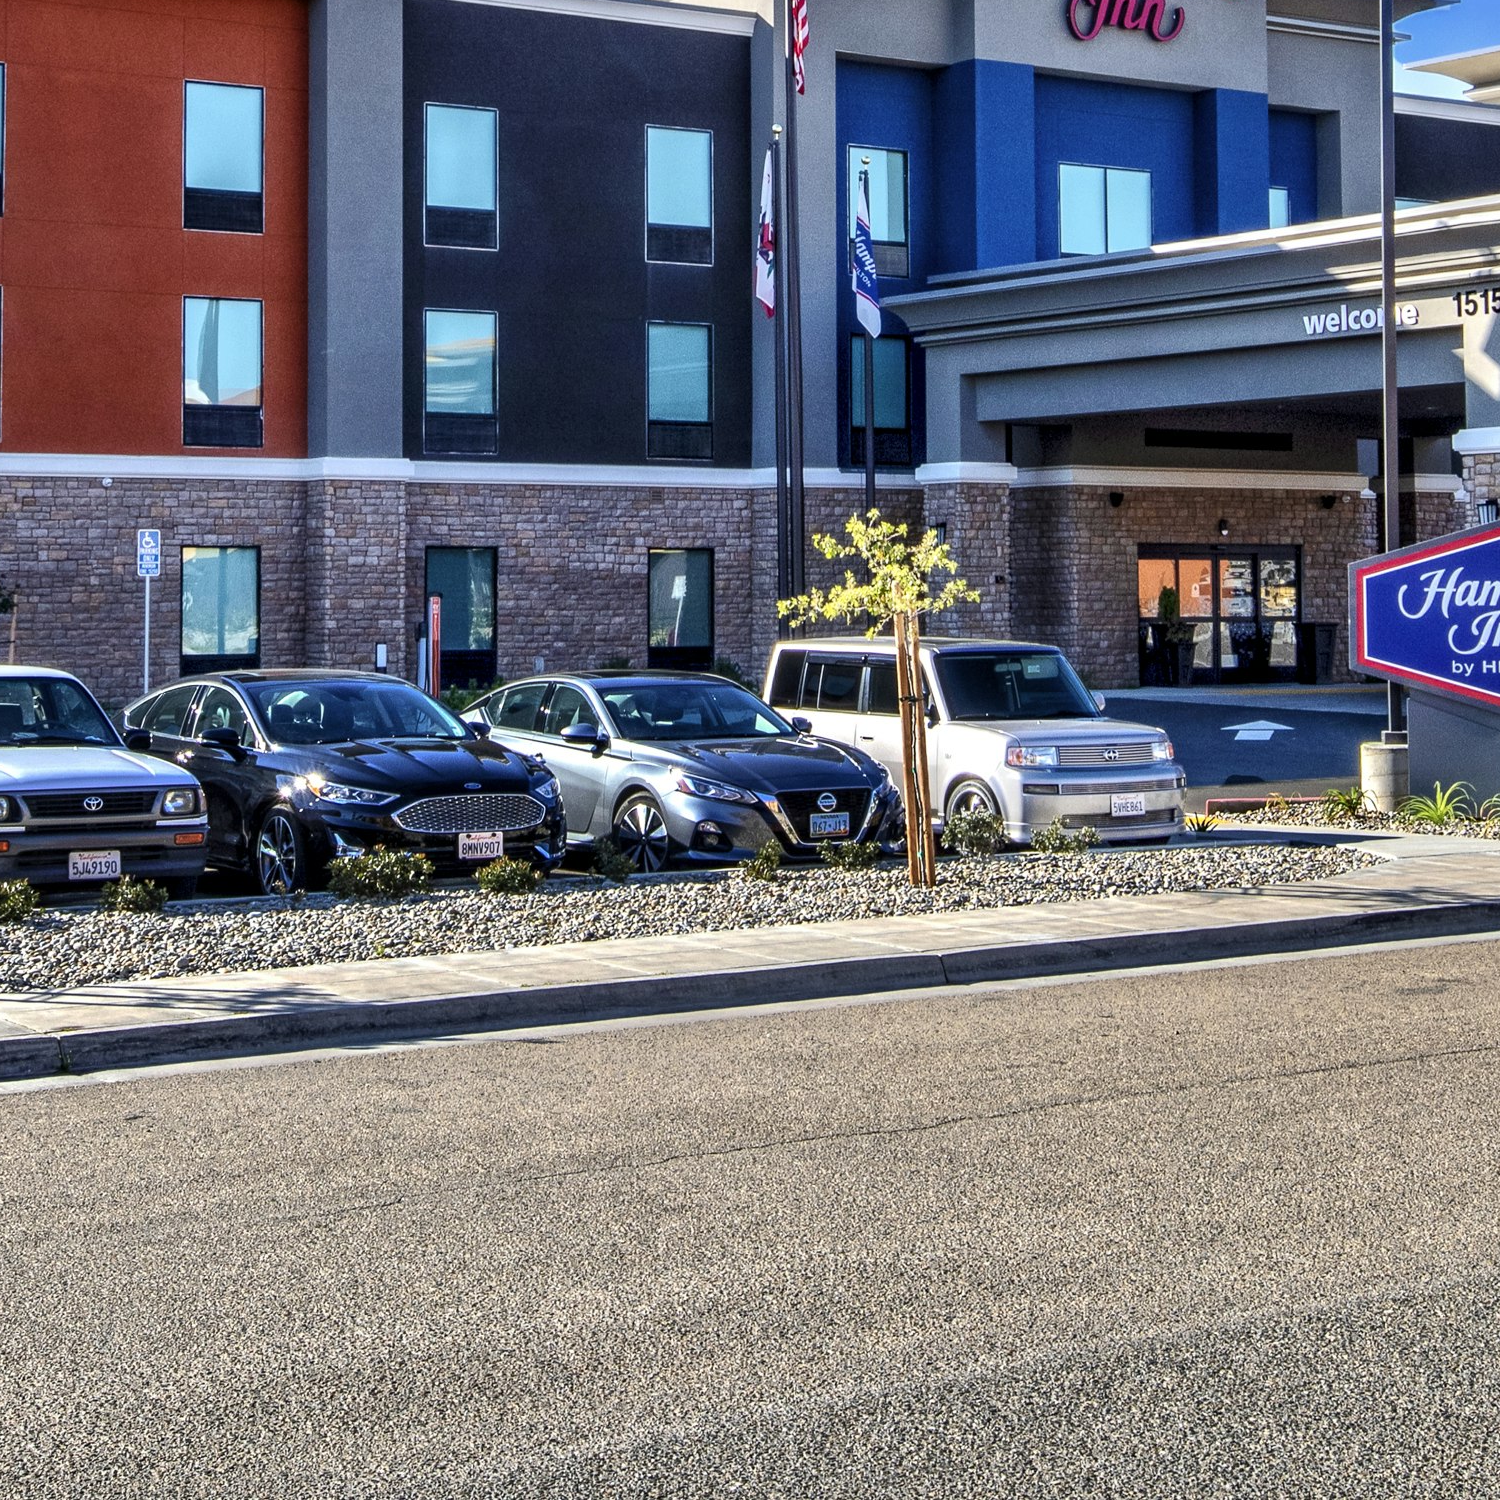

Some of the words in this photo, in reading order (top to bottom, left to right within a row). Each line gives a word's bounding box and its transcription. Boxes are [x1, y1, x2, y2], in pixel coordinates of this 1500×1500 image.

[1451, 660, 1475, 677] by
[1113, 801, 1143, 813] 5VHE861
[462, 841, 500, 855] 8MNV907
[72, 861, 118, 875] 5J49190
